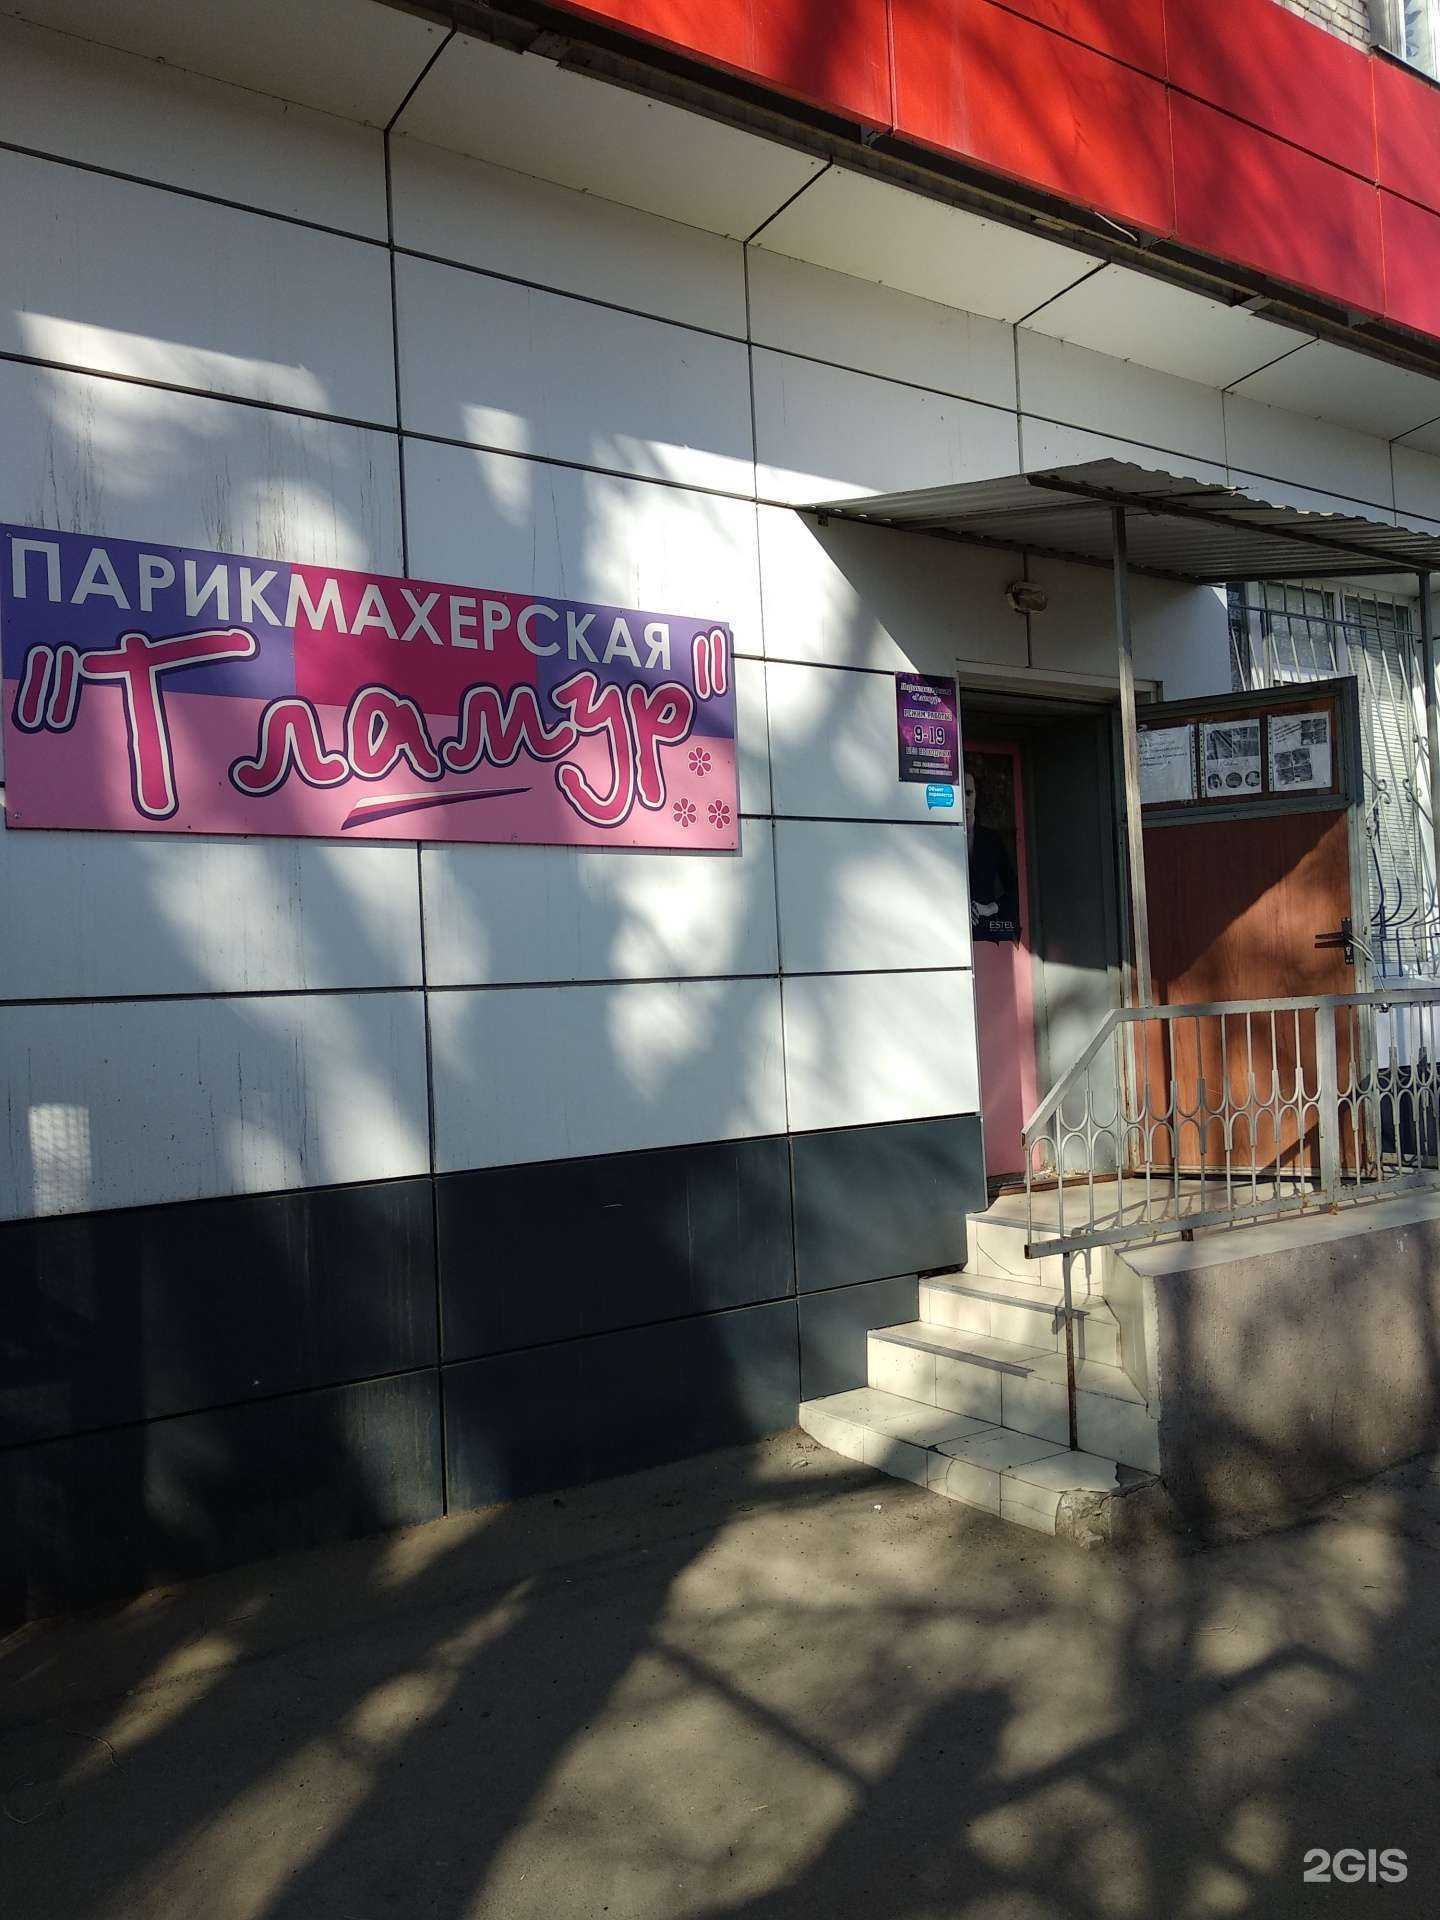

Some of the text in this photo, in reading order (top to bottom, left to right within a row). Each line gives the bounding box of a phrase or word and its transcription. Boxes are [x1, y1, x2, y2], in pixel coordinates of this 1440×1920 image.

[11, 537, 672, 671] ПАРИКМАХЕРСКАЯ
[913, 725, 945, 745] 9-19
[989, 920, 1016, 929] ESTEL
